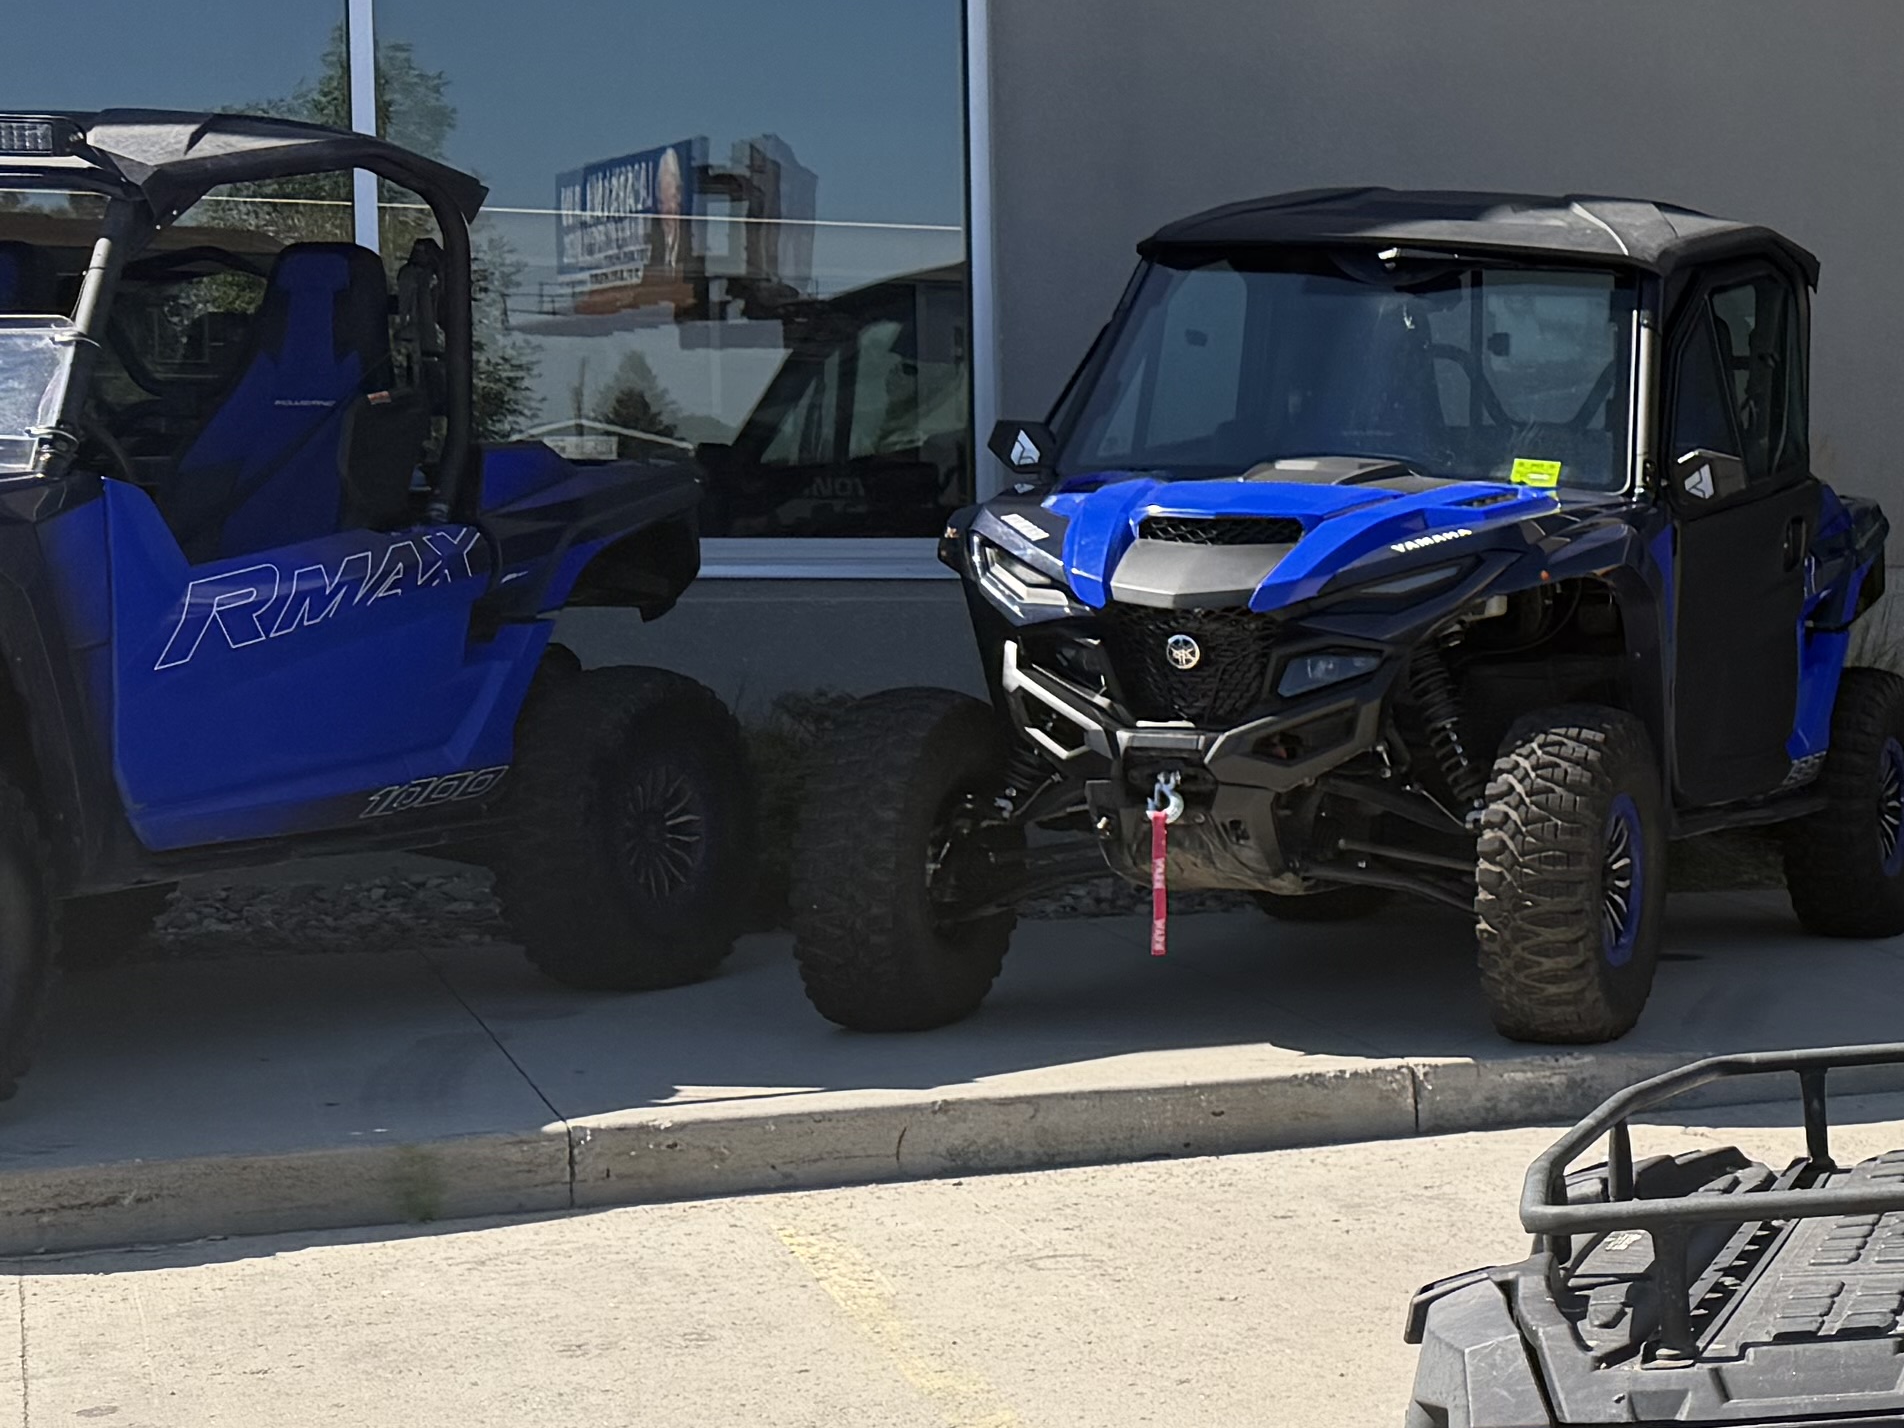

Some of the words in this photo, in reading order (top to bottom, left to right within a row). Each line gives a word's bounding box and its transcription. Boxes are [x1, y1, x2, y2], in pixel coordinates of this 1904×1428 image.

[1390, 528, 1473, 553] YAMAHA
[154, 526, 481, 671] RMAX
[358, 765, 509, 819] 1000
